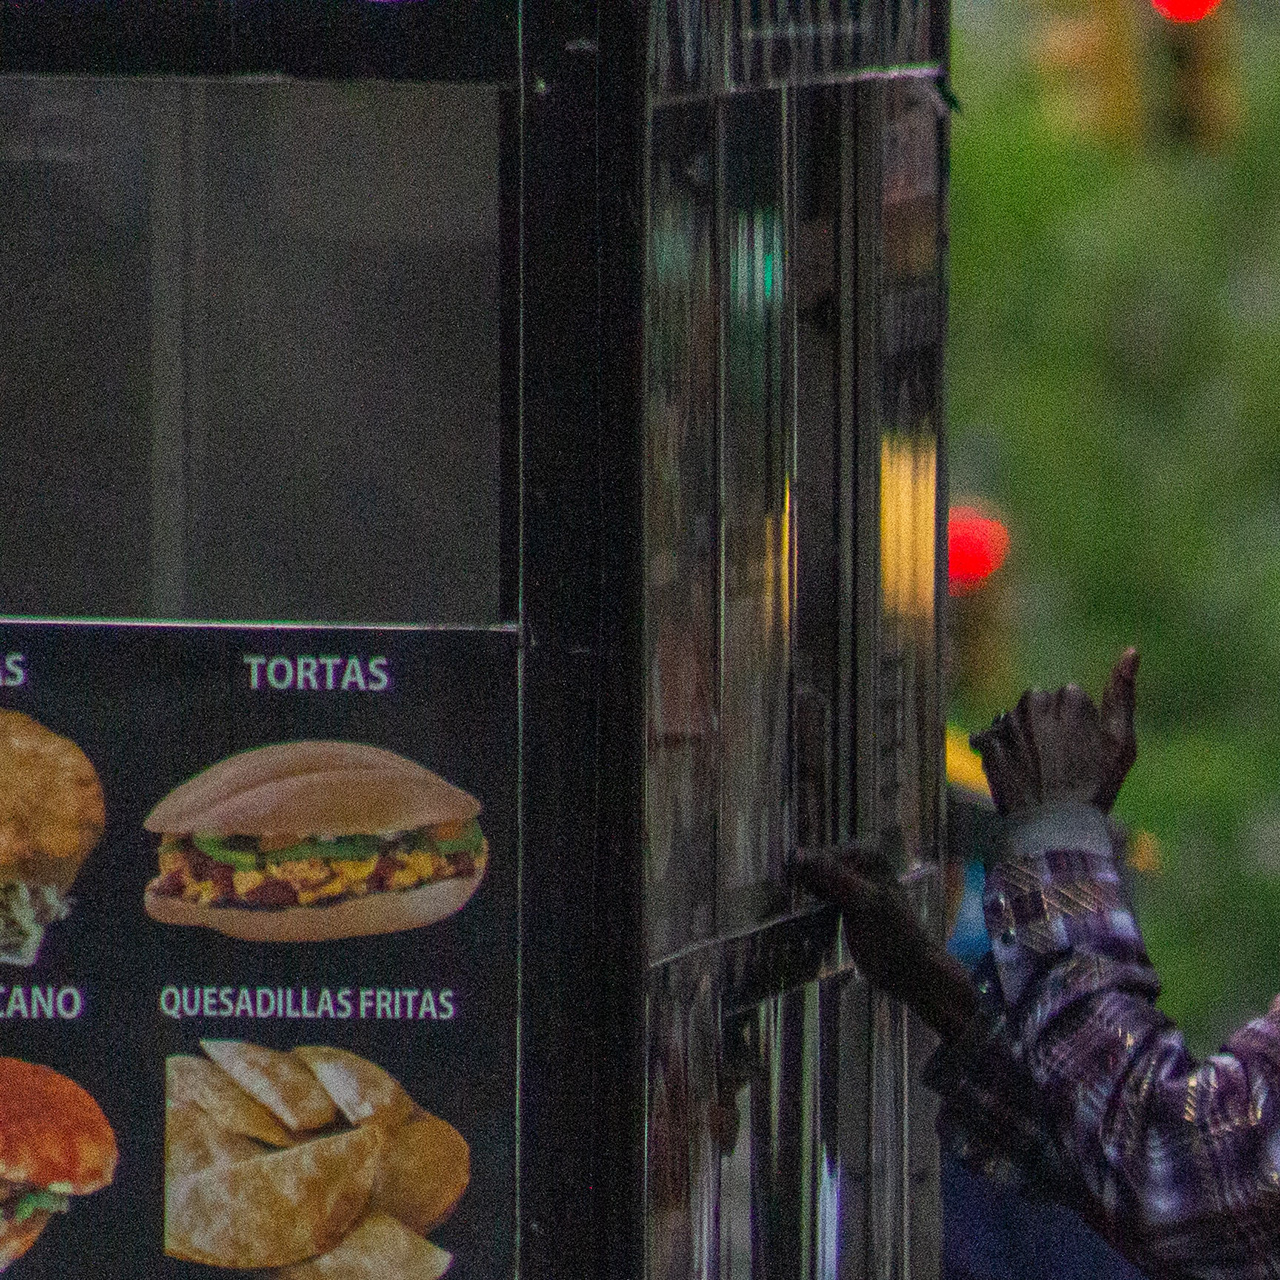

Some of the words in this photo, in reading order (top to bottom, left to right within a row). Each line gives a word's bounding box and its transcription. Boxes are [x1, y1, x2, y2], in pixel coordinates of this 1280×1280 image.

[0, 651, 26, 687] S
[243, 654, 388, 691] TORTAS
[160, 985, 351, 1018] QUESADILLAS
[359, 987, 455, 1019] FRITAS
